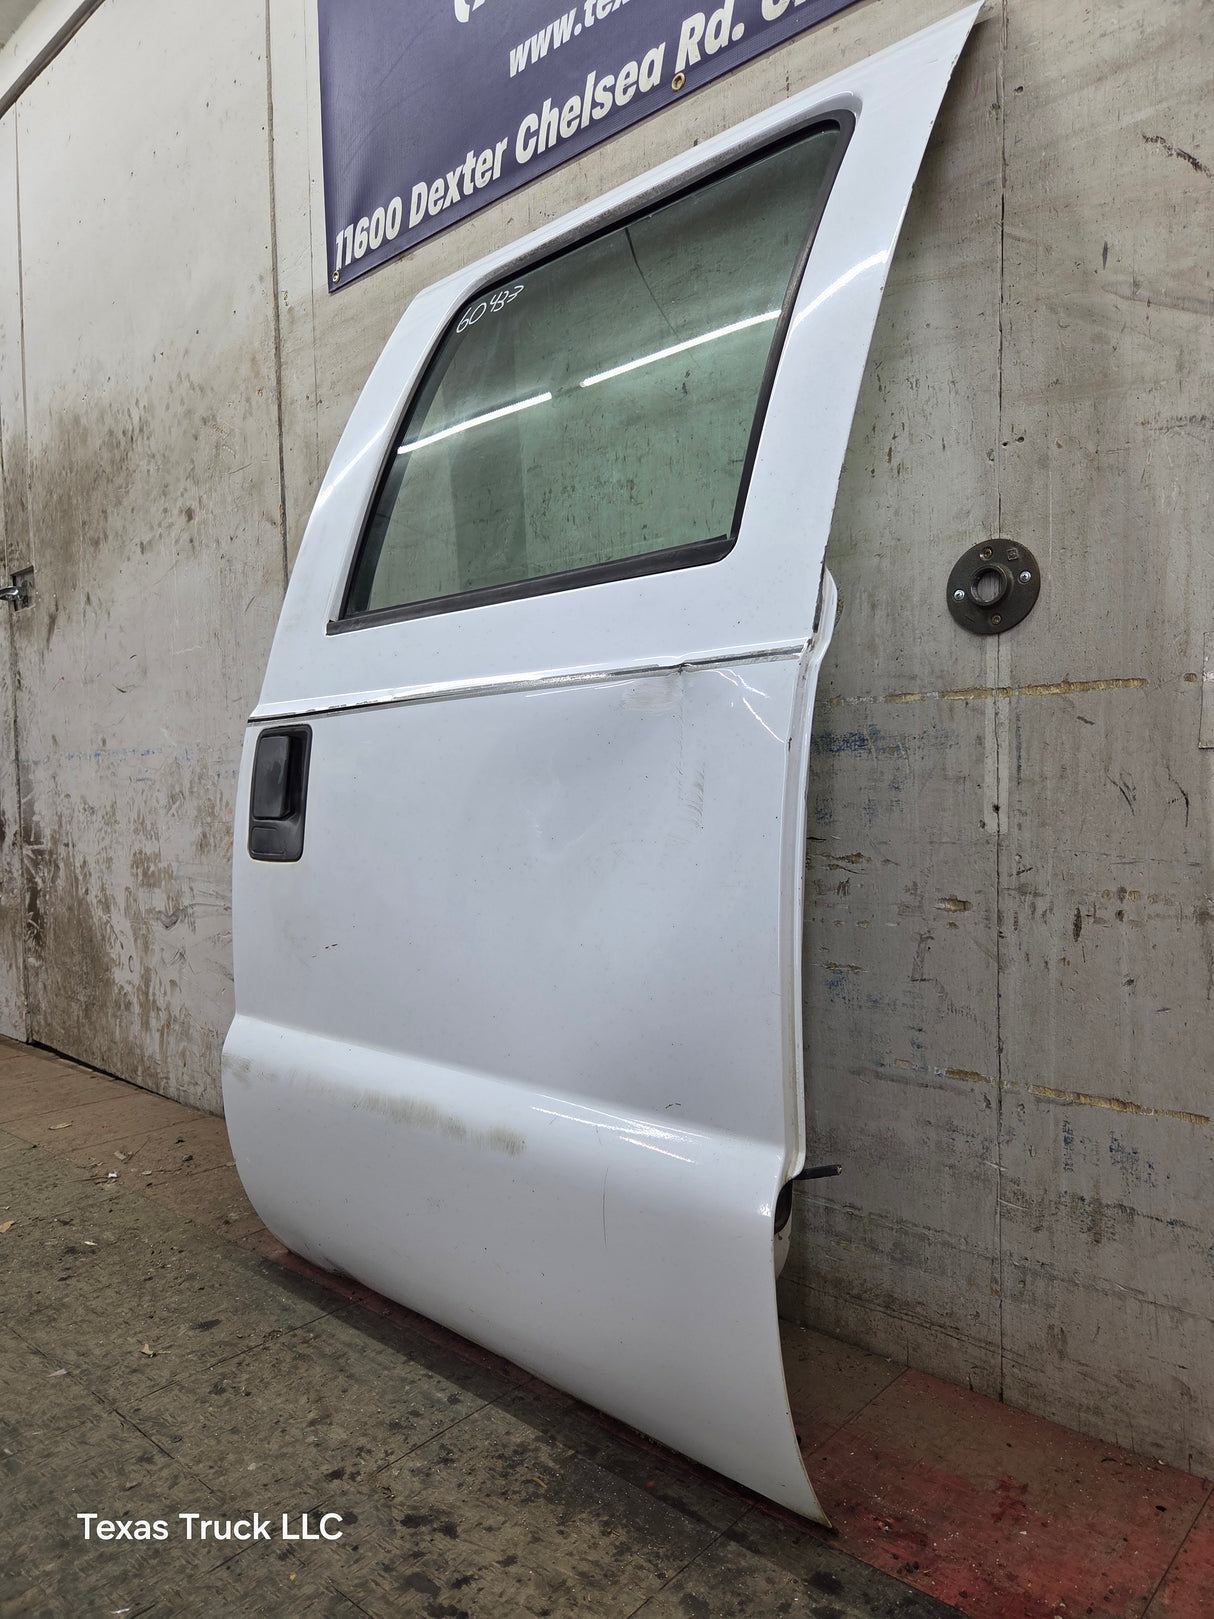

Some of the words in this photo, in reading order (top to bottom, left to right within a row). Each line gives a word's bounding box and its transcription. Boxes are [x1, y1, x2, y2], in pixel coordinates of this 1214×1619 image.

[335, 196, 403, 271] 11600
[408, 139, 508, 229] Dexter
[515, 41, 666, 164] Chelsea
[675, 0, 745, 74] Rd.
